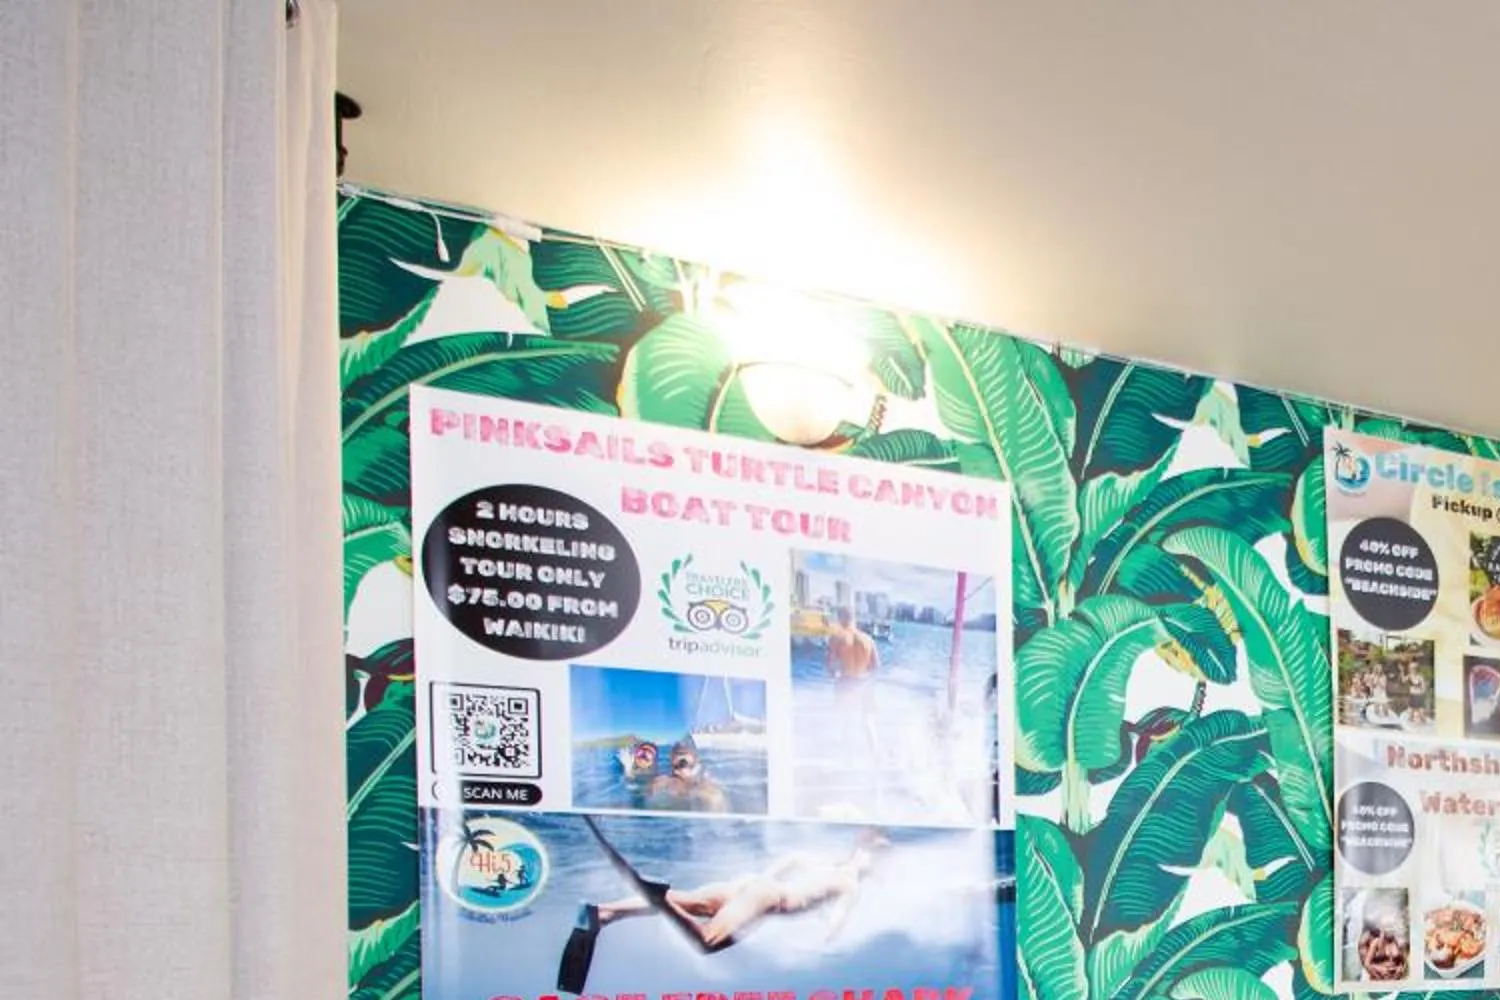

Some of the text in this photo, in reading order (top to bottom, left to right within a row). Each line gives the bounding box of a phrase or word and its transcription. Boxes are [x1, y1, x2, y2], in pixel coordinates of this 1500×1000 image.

[429, 408, 998, 518] PINKSAILS TURTLE CANYON
[1375, 453, 1474, 493] Circle
[476, 501, 589, 531] 2 HOURS
[621, 485, 852, 543] BOAT TOUR
[1432, 494, 1493, 522] Pickup
[448, 526, 616, 561] SNORKELING
[1359, 539, 1419, 559] 40% OFF
[460, 557, 606, 589] TOUR ONLY
[1345, 557, 1433, 581] PROMO CODE
[448, 584, 618, 619] $75.00 FROM
[685, 583, 749, 600] CHOICE
[483, 617, 585, 643] WAIKIKI
[669, 637, 759, 657] tripadvisor
[463, 787, 528, 801] SCAN ME
